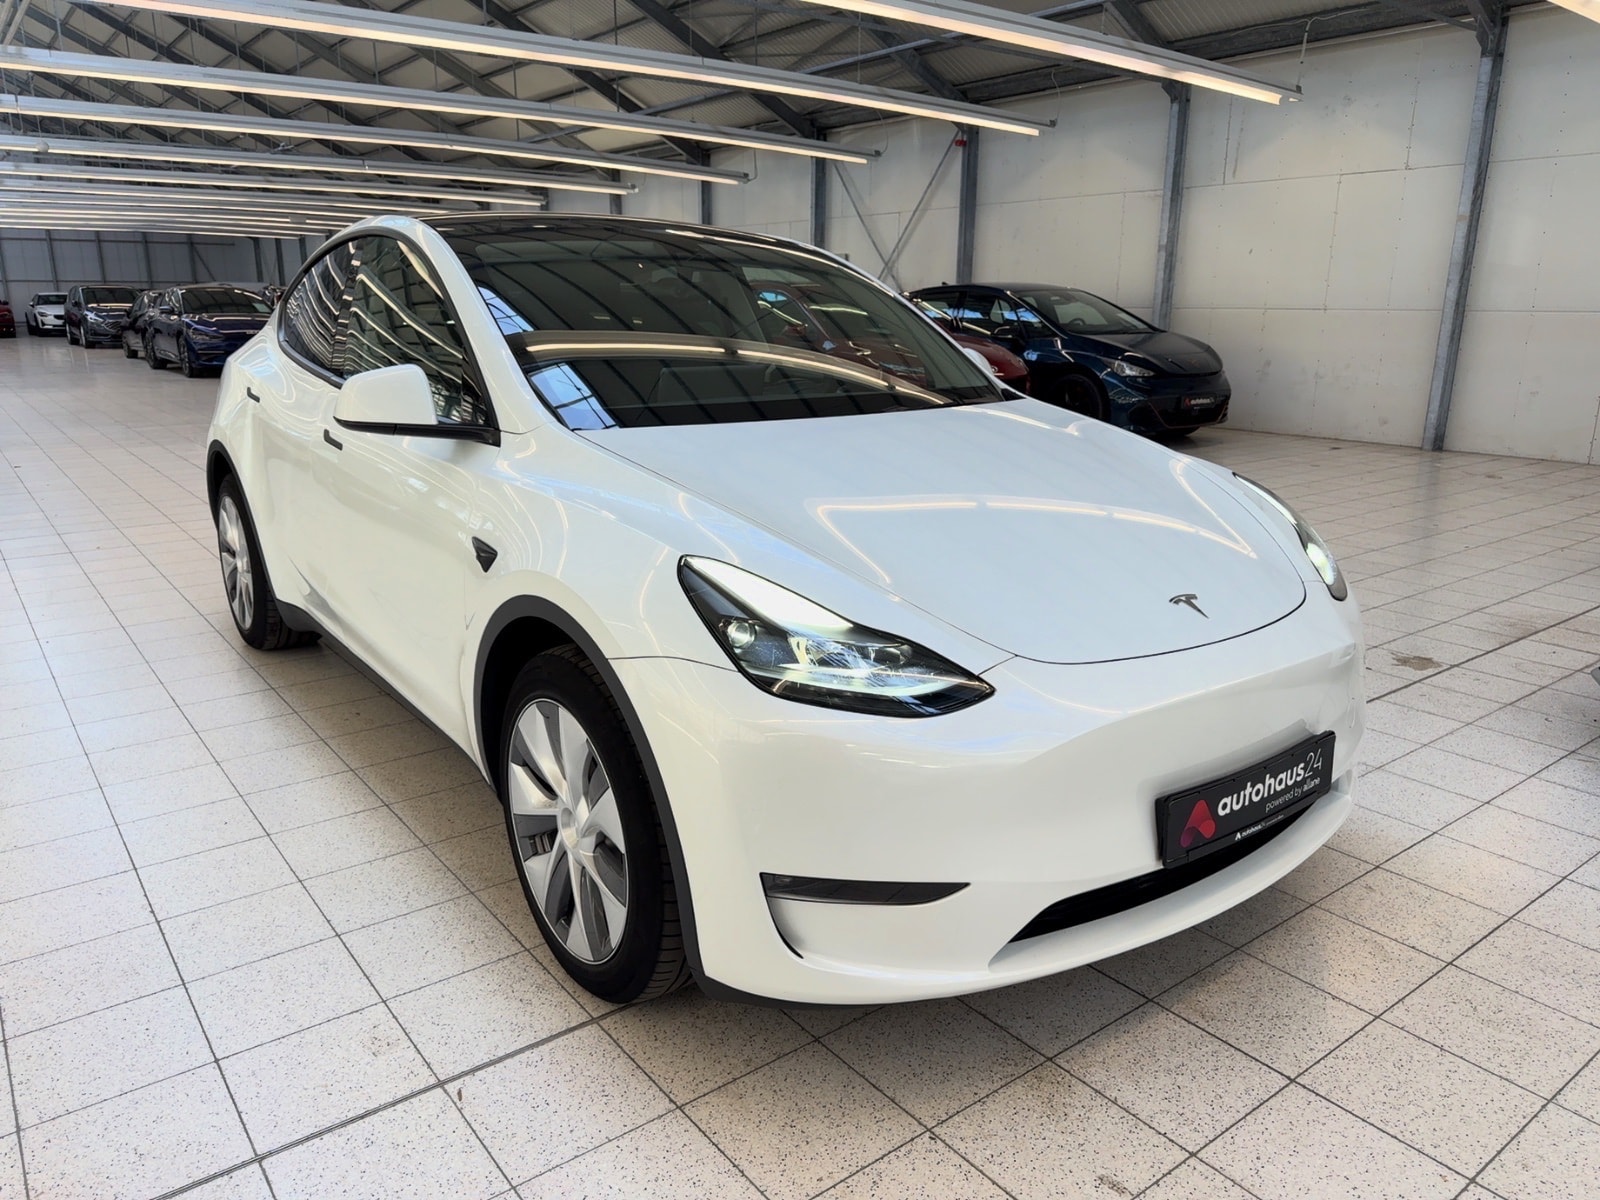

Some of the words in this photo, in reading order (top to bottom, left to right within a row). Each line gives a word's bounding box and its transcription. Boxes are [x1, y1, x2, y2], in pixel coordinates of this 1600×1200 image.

[1217, 748, 1323, 817] autohaus24
[1265, 788, 1294, 813] powered
[1294, 786, 1303, 798] by
